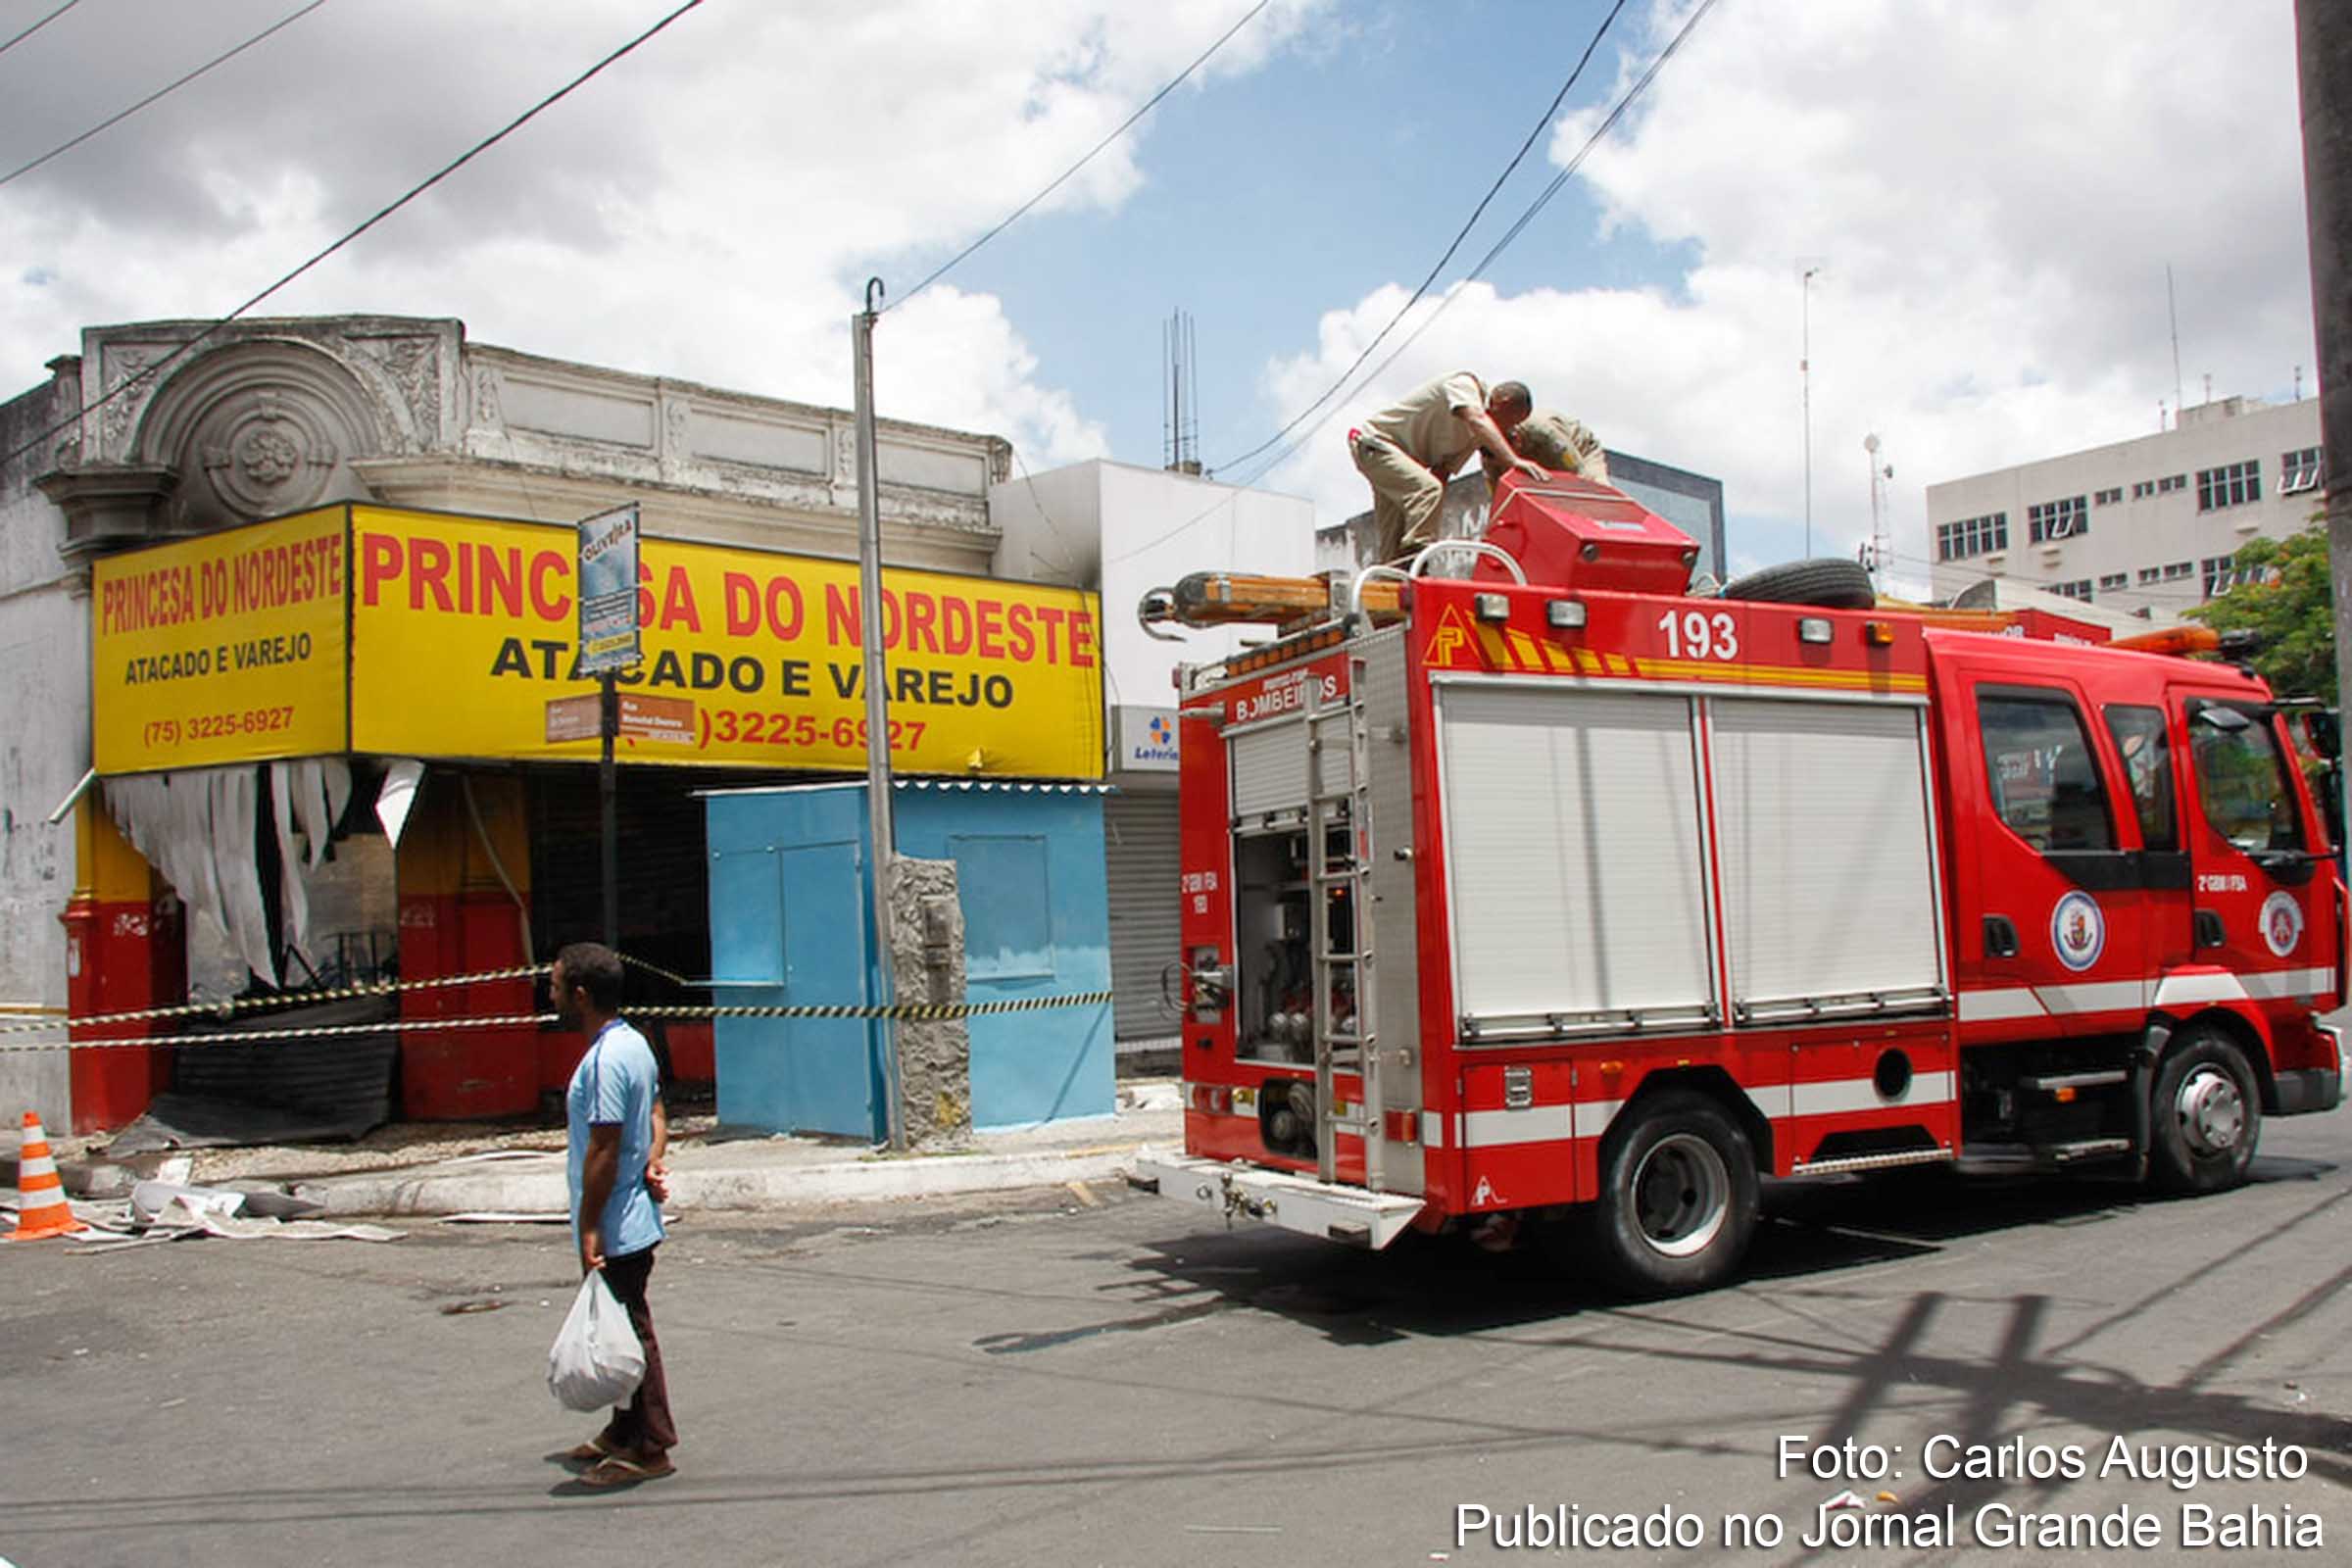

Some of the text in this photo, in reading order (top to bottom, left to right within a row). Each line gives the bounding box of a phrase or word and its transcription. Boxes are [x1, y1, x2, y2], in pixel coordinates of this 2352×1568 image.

[103, 533, 343, 637] PRINCESA DO NORDESTE
[362, 532, 1095, 668] PRINCSA DO NORDESTE
[124, 632, 313, 685] ATACADO E VAREJO
[1658, 610, 1739, 661] 193
[781, 660, 811, 698] E
[1237, 674, 1338, 720] BOMBEIS
[143, 706, 295, 749] (75) 3225-6927
